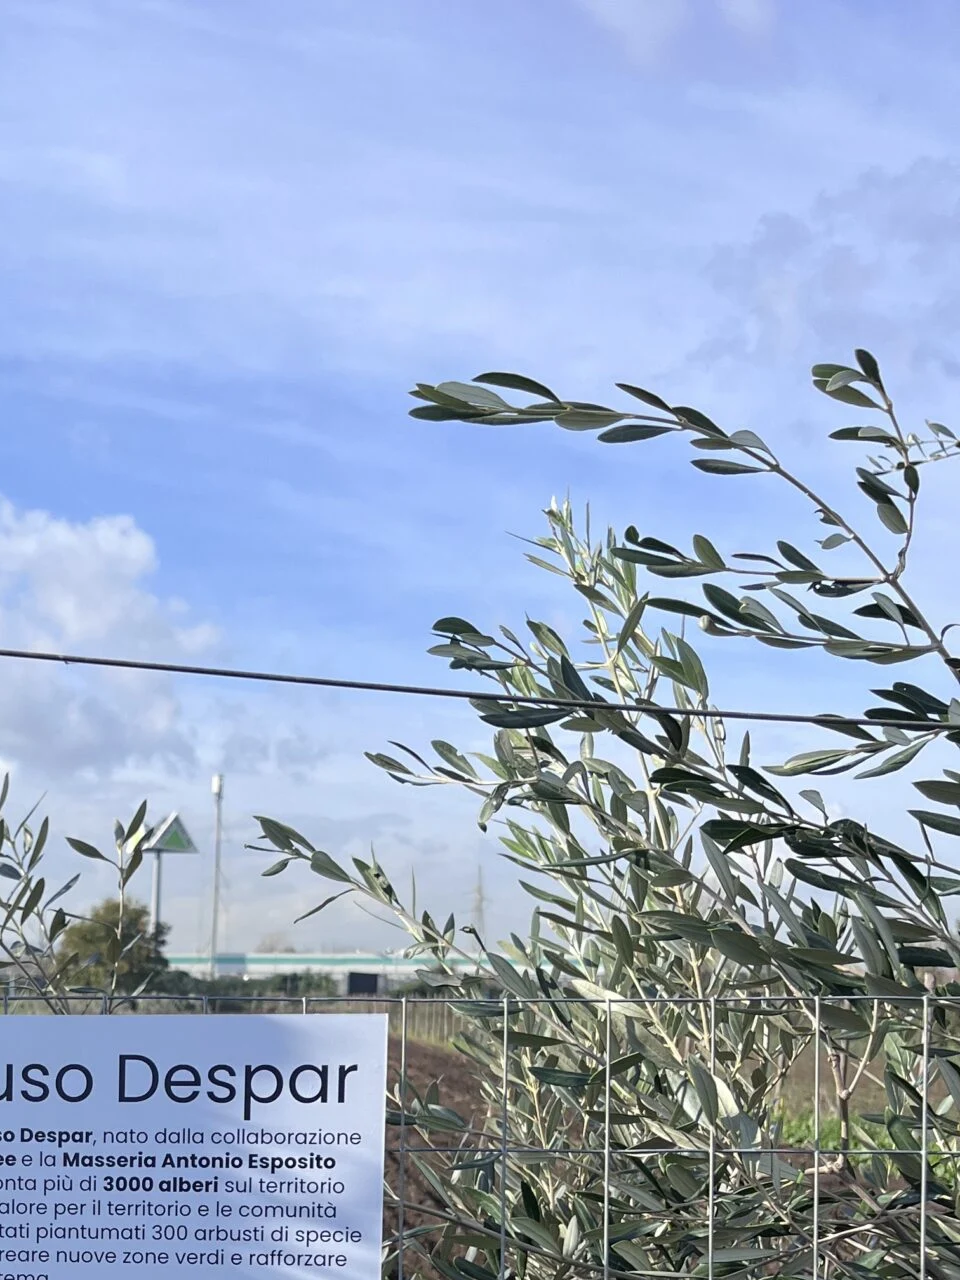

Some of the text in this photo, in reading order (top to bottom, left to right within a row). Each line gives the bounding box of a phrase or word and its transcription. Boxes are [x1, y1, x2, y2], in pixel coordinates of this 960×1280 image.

[117, 1053, 359, 1122] Despar
[19, 1127, 97, 1149] Despar,
[102, 1128, 149, 1144] nato
[154, 1127, 205, 1145] dalla
[210, 1127, 362, 1146] collaborazione
[20, 1154, 33, 1168] e
[39, 1150, 57, 1168] la
[62, 1150, 157, 1169] Masseria
[160, 1151, 244, 1169] Antonio
[247, 1151, 337, 1175] Esposito
[43, 1174, 73, 1197] più
[79, 1174, 97, 1192] di
[102, 1175, 154, 1193] 3000
[158, 1175, 219, 1193] alberi
[224, 1176, 253, 1194] sul
[257, 1176, 345, 1195] territorio
[53, 1202, 87, 1221] per
[92, 1199, 101, 1216] il
[106, 1199, 192, 1217] territorio
[197, 1204, 210, 1218] e
[215, 1200, 233, 1218] le
[238, 1200, 337, 1219] comunità
[35, 1222, 146, 1245] piantumati
[151, 1224, 189, 1241] 300
[193, 1224, 265, 1242] arbusti
[270, 1225, 289, 1243] di
[294, 1226, 363, 1248] specie
[55, 1250, 117, 1264] nuove
[122, 1251, 170, 1265] zone
[174, 1248, 225, 1266] verdi
[230, 1252, 243, 1266] e
[248, 1249, 348, 1268] rafforzare
